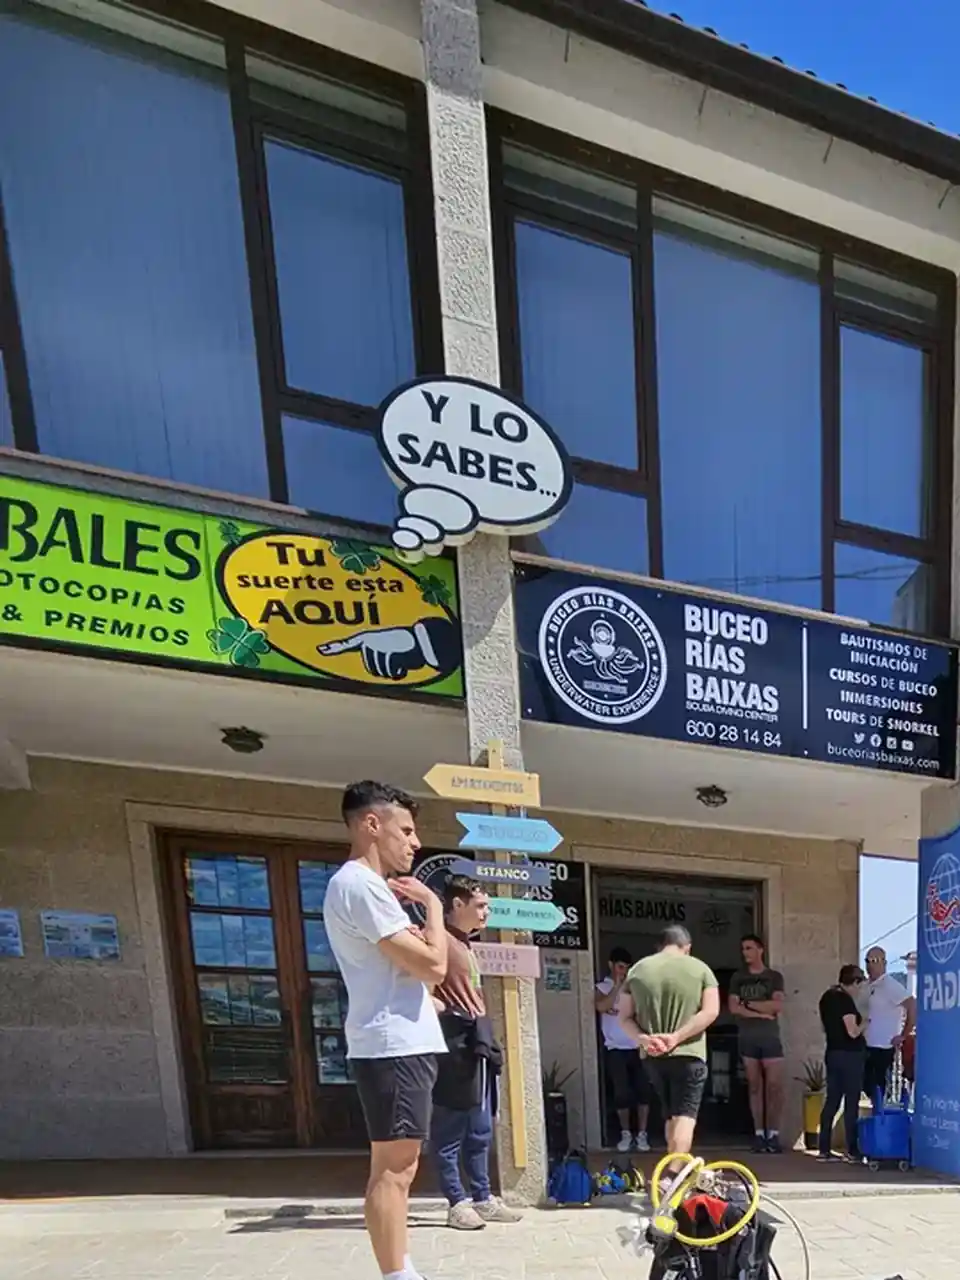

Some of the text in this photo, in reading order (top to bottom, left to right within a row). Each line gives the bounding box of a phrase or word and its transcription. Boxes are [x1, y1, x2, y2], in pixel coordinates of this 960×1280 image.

[421, 389, 529, 443] Y LO
[266, 541, 326, 567] Tu
[237, 573, 405, 594] suerte esta
[259, 595, 381, 626] AQUÍ
[549, 597, 580, 634] BUCEO
[619, 603, 656, 649] BAIXAS
[684, 603, 769, 645] BUCEO
[44, 609, 190, 646] PREMIOS
[685, 635, 746, 675] RÍAS
[840, 632, 928, 660] BAUTISMOS DE
[850, 650, 918, 674] INICIACIÓN
[548, 657, 661, 717] UNDERWATER EXPERIENCE
[686, 672, 780, 713] BAIXAS
[829, 668, 938, 697] CURSOS DE BUCEO
[840, 690, 924, 714] INMERSIONES
[686, 719, 782, 748] 600 28 14 84
[826, 707, 940, 737] TOURS DE SNORKEL
[827, 741, 940, 770] buceoriasbaixas.com
[476, 866, 530, 881] ESTANCO
[636, 900, 686, 921] BAIXAS
